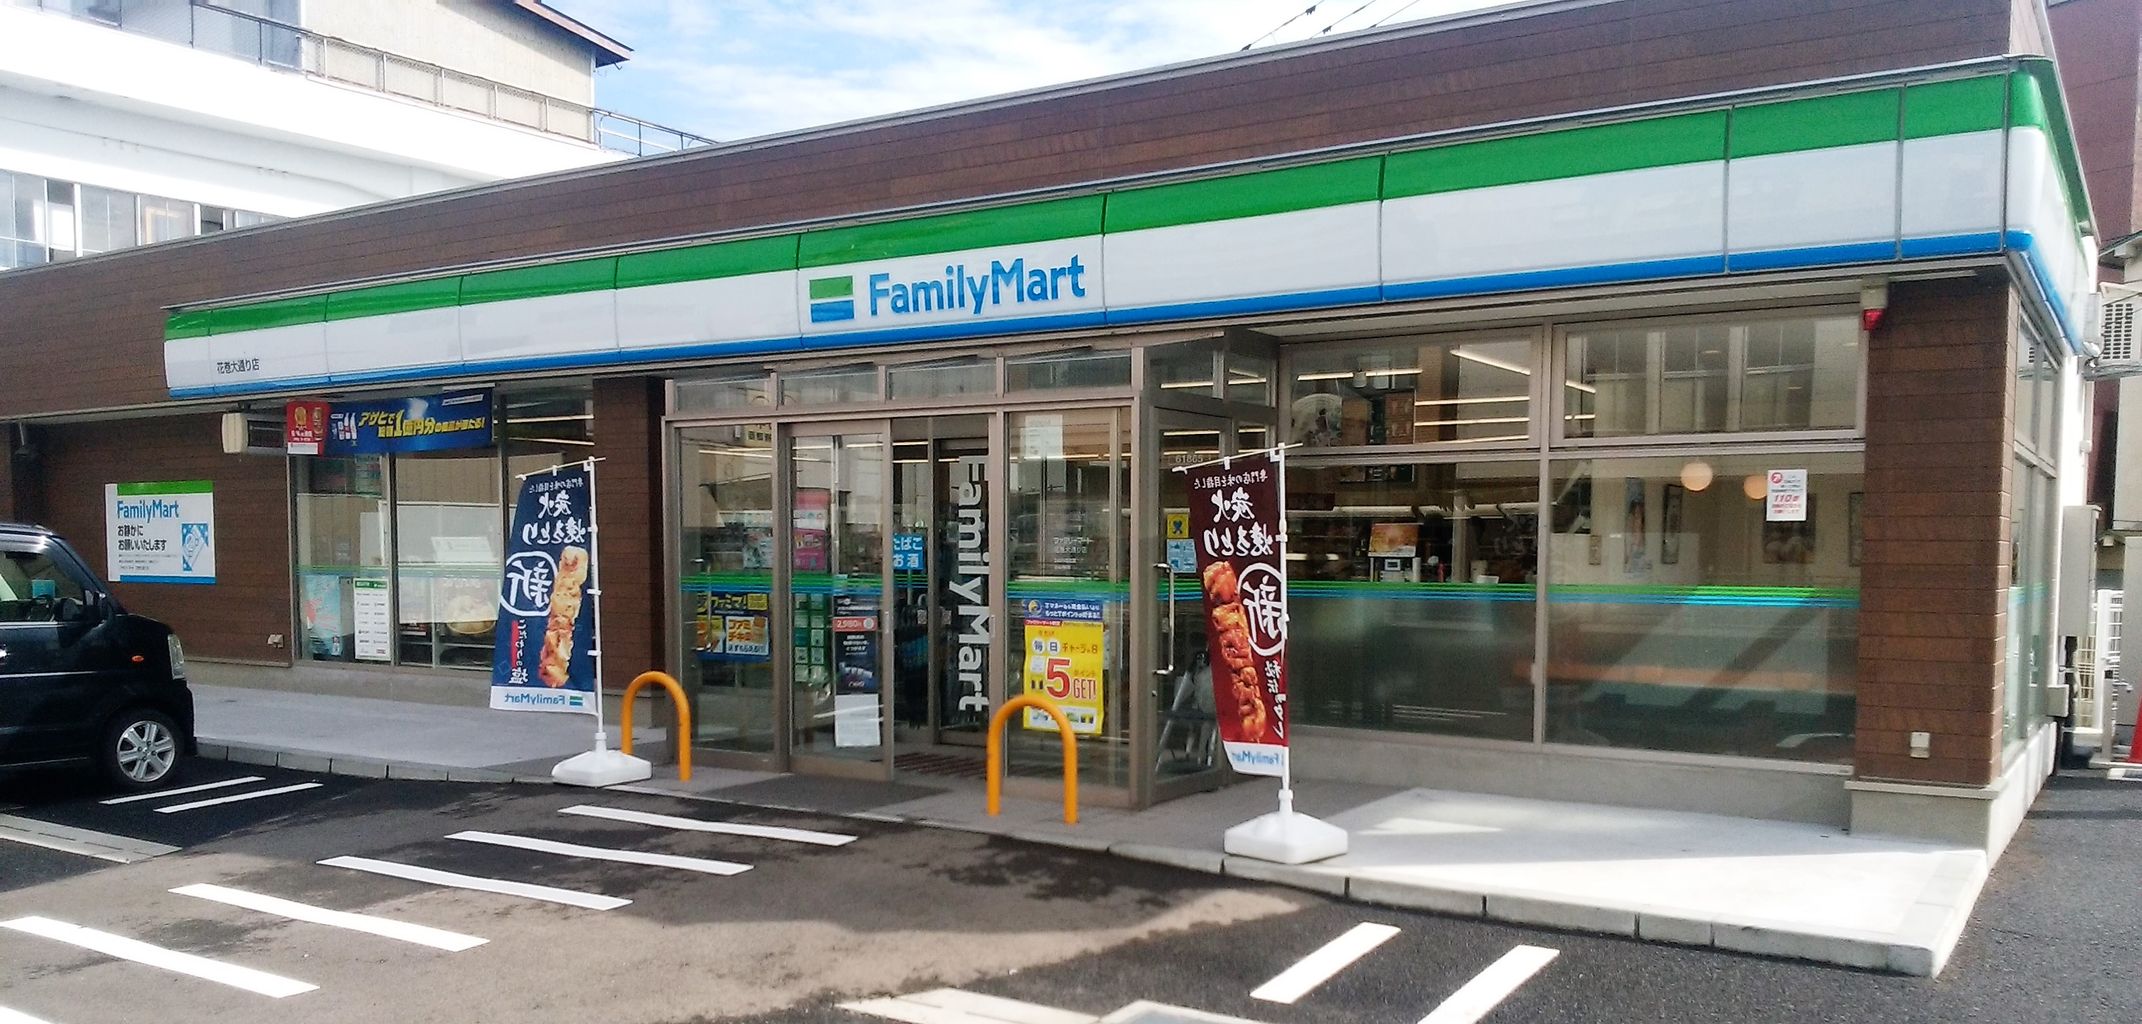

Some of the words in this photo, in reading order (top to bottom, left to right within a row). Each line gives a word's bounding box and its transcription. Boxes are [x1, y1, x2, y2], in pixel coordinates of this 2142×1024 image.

[869, 254, 1086, 316] FamilyMart
[216, 358, 260, 375] 花巻大通り店
[359, 410, 397, 426] アサヒで
[117, 499, 179, 524] FamilyMart
[117, 524, 144, 538] お静かに
[118, 539, 168, 551] お願いいたします
[893, 536, 923, 551] たばこ
[893, 553, 920, 569] お酒
[950, 455, 990, 712] FamilyMart
[1046, 658, 1071, 698] 5
[1073, 679, 1097, 700] GET!
